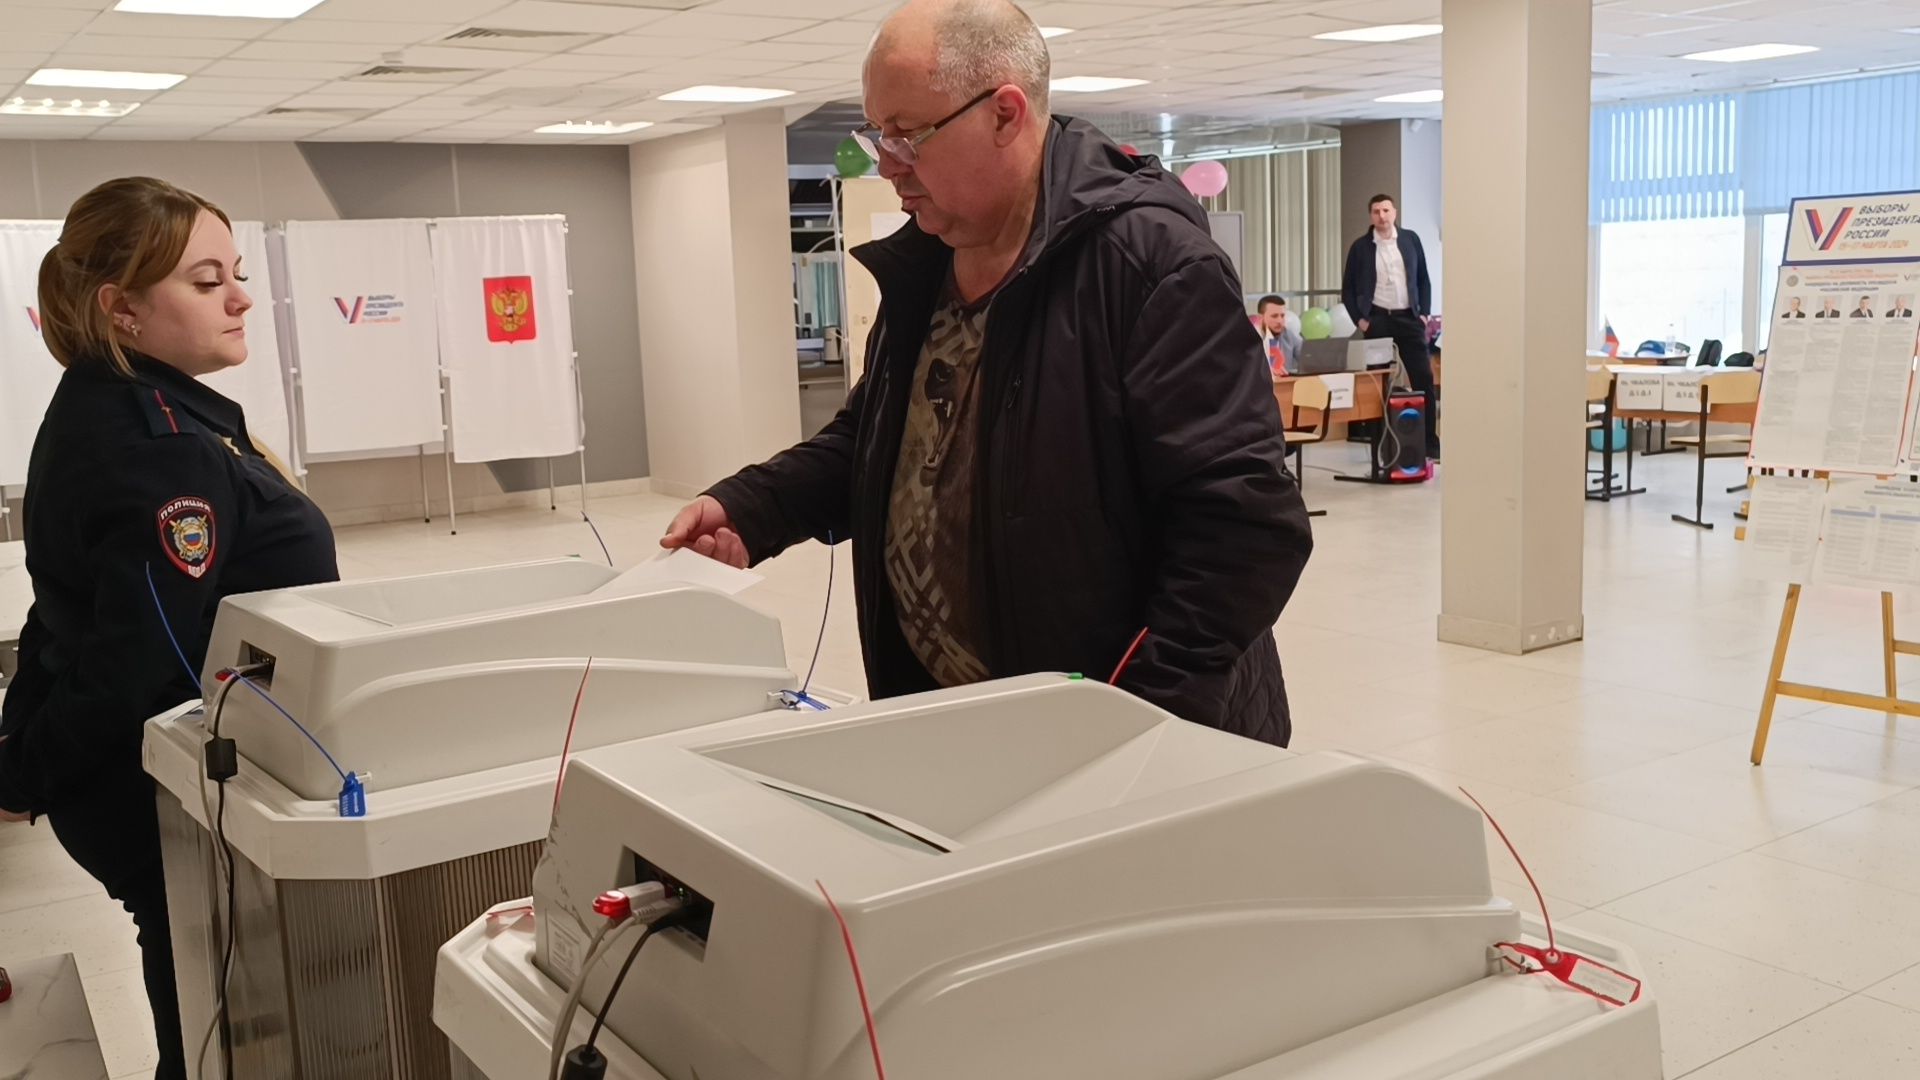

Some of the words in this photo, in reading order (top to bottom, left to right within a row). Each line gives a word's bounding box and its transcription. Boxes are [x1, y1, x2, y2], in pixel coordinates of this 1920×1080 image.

[1859, 203, 1910, 215] ВЫБОРЫ
[1844, 229, 1890, 240] РОССИИ
[160, 499, 211, 520] ПОЛИЦИЯ
